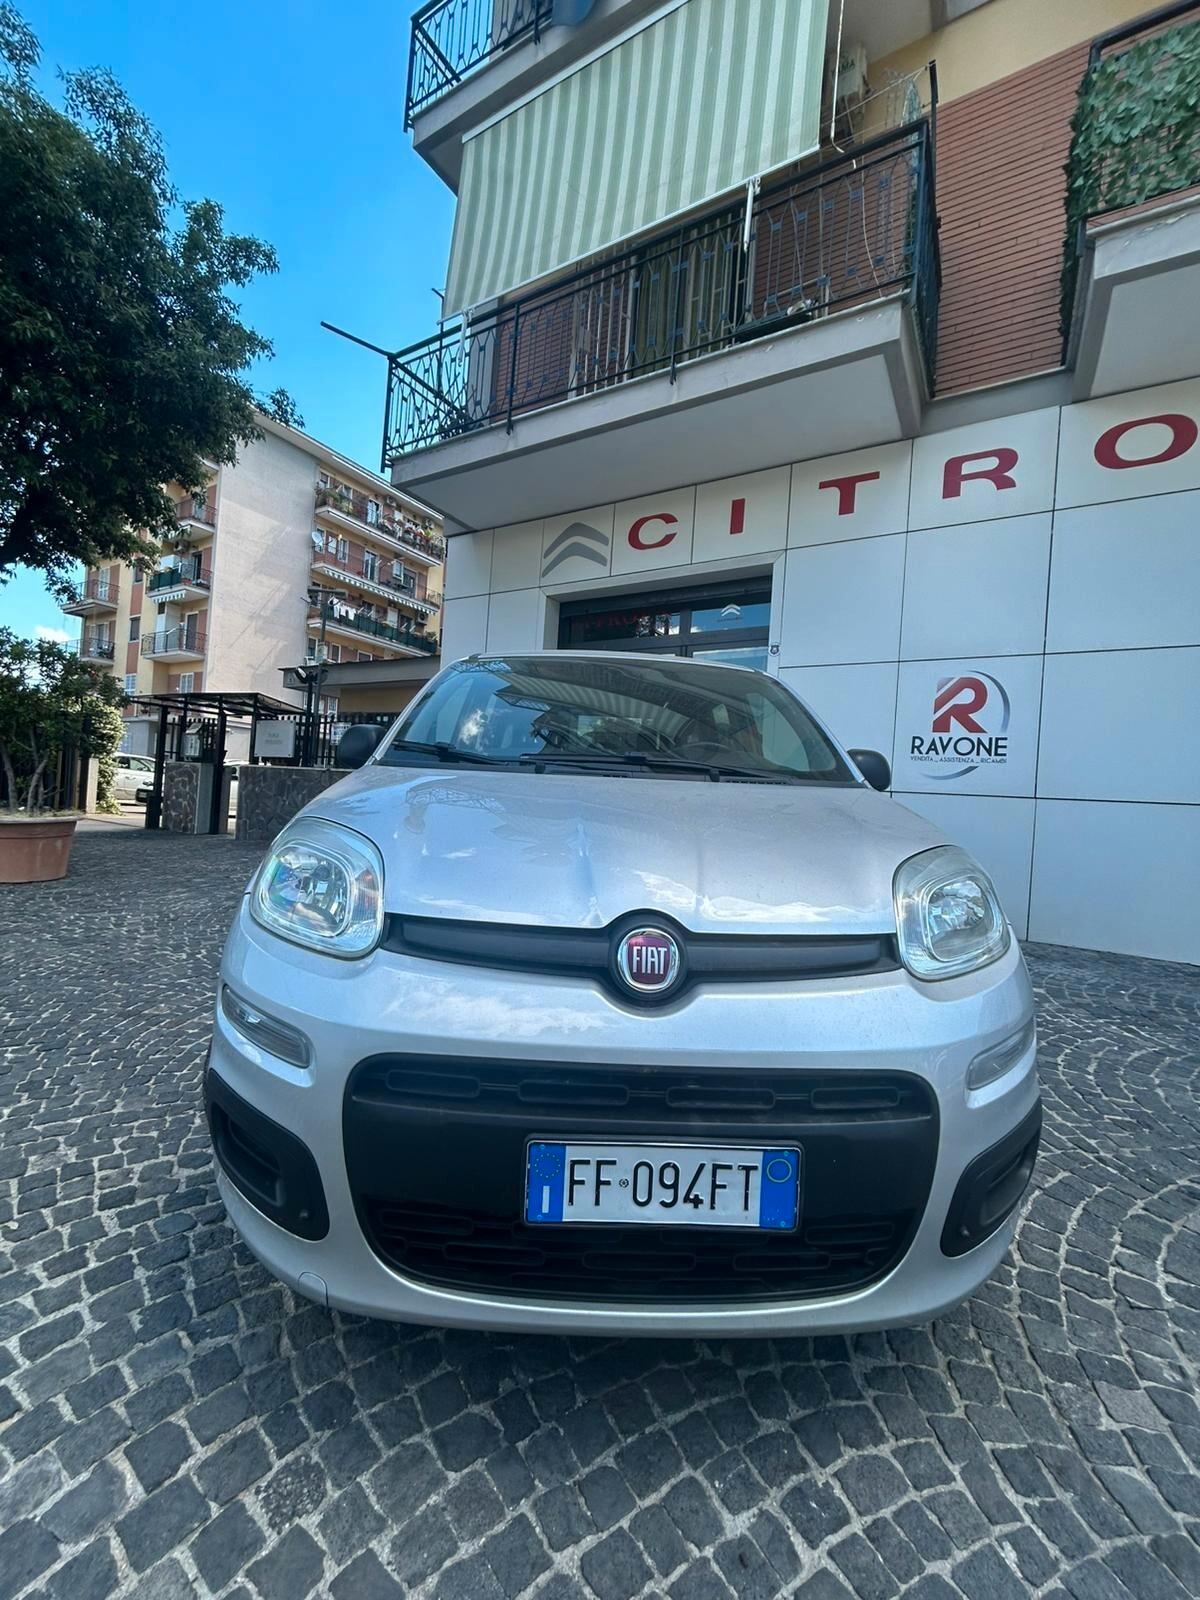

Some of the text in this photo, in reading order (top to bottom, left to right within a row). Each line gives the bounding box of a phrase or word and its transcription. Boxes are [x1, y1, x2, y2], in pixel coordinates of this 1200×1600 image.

[910, 735, 1008, 757] RAVONE
[632, 946, 667, 975] FIAT
[568, 1159, 758, 1211] FF 094FT
